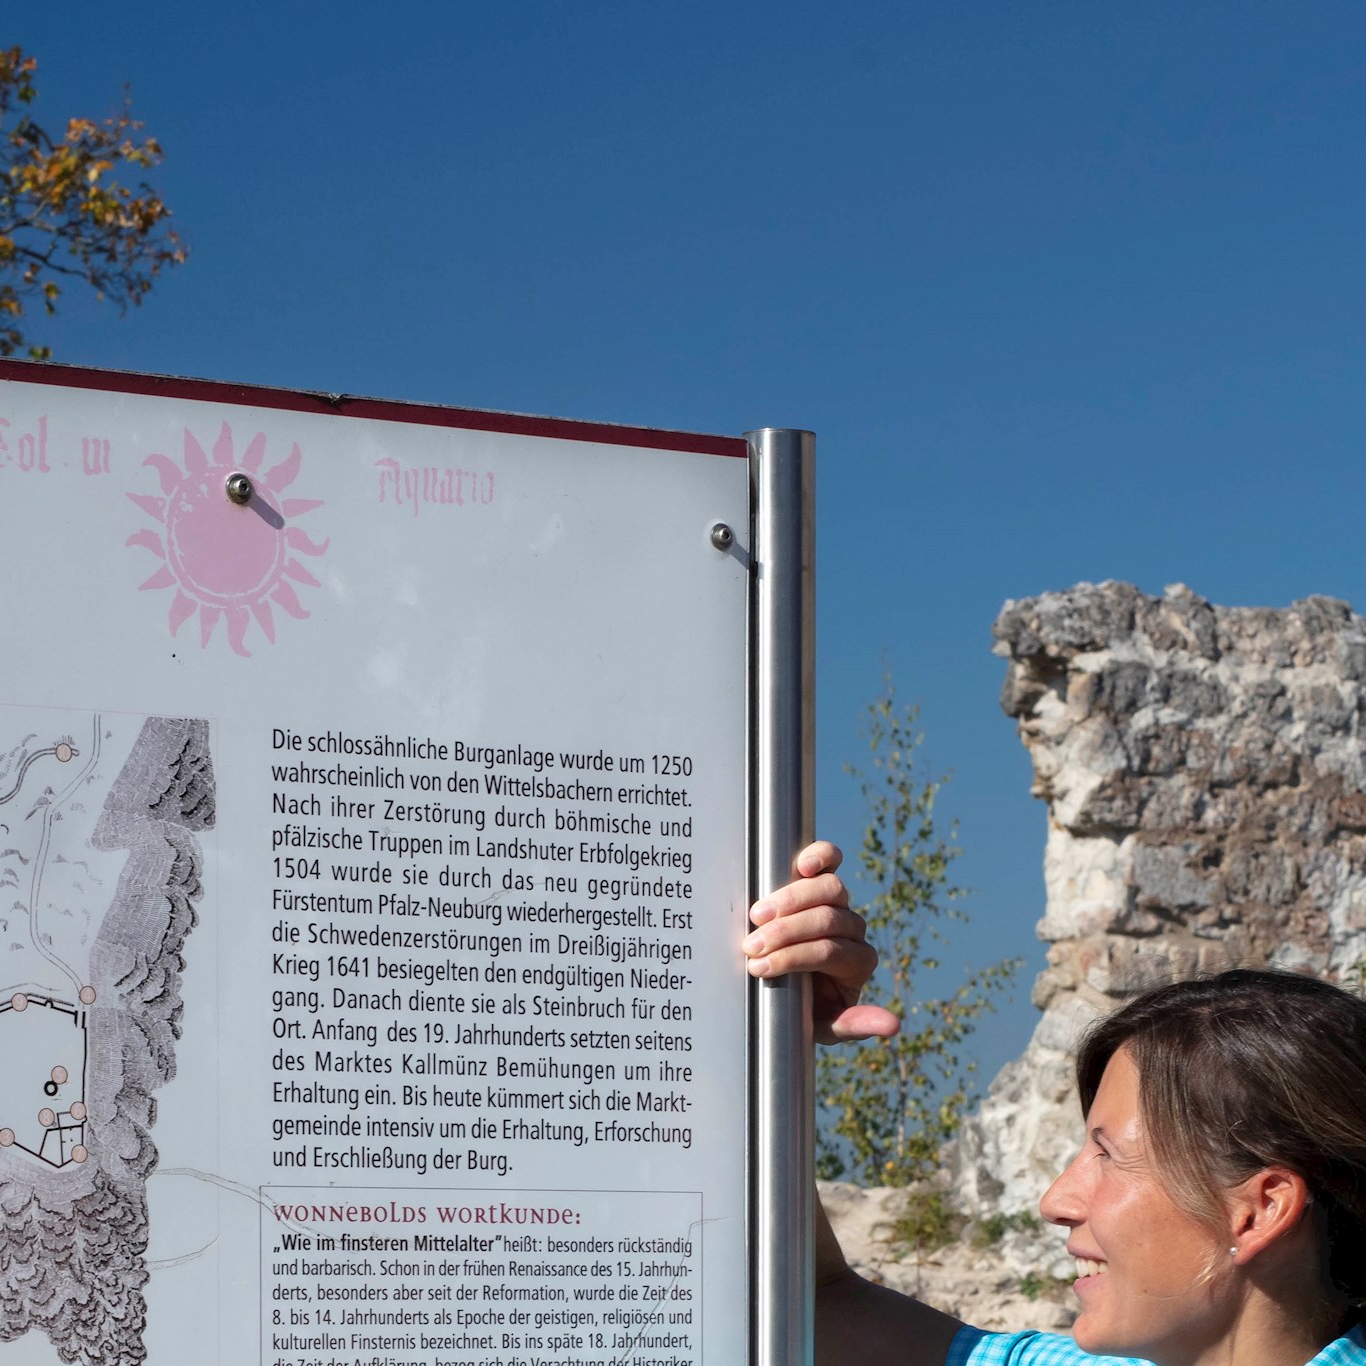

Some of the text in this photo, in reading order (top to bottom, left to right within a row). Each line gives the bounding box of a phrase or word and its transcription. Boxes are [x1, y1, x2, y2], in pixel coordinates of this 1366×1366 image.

[273, 728, 692, 776] Die schlossähnliche Burganlage wurde um 1250
[271, 760, 692, 807] wahrscheinlich von den Wittelsbachern errichtet.
[273, 792, 692, 838] Nach ihrer Zerstörung durch böhmische und
[273, 1144, 513, 1176] und Erschließung der Burg.
[316, 1233, 335, 1251] im
[340, 1233, 408, 1251] finsteren
[503, 1235, 542, 1252] heißt:
[547, 1235, 614, 1253] besonders
[618, 1236, 692, 1258] rückständig
